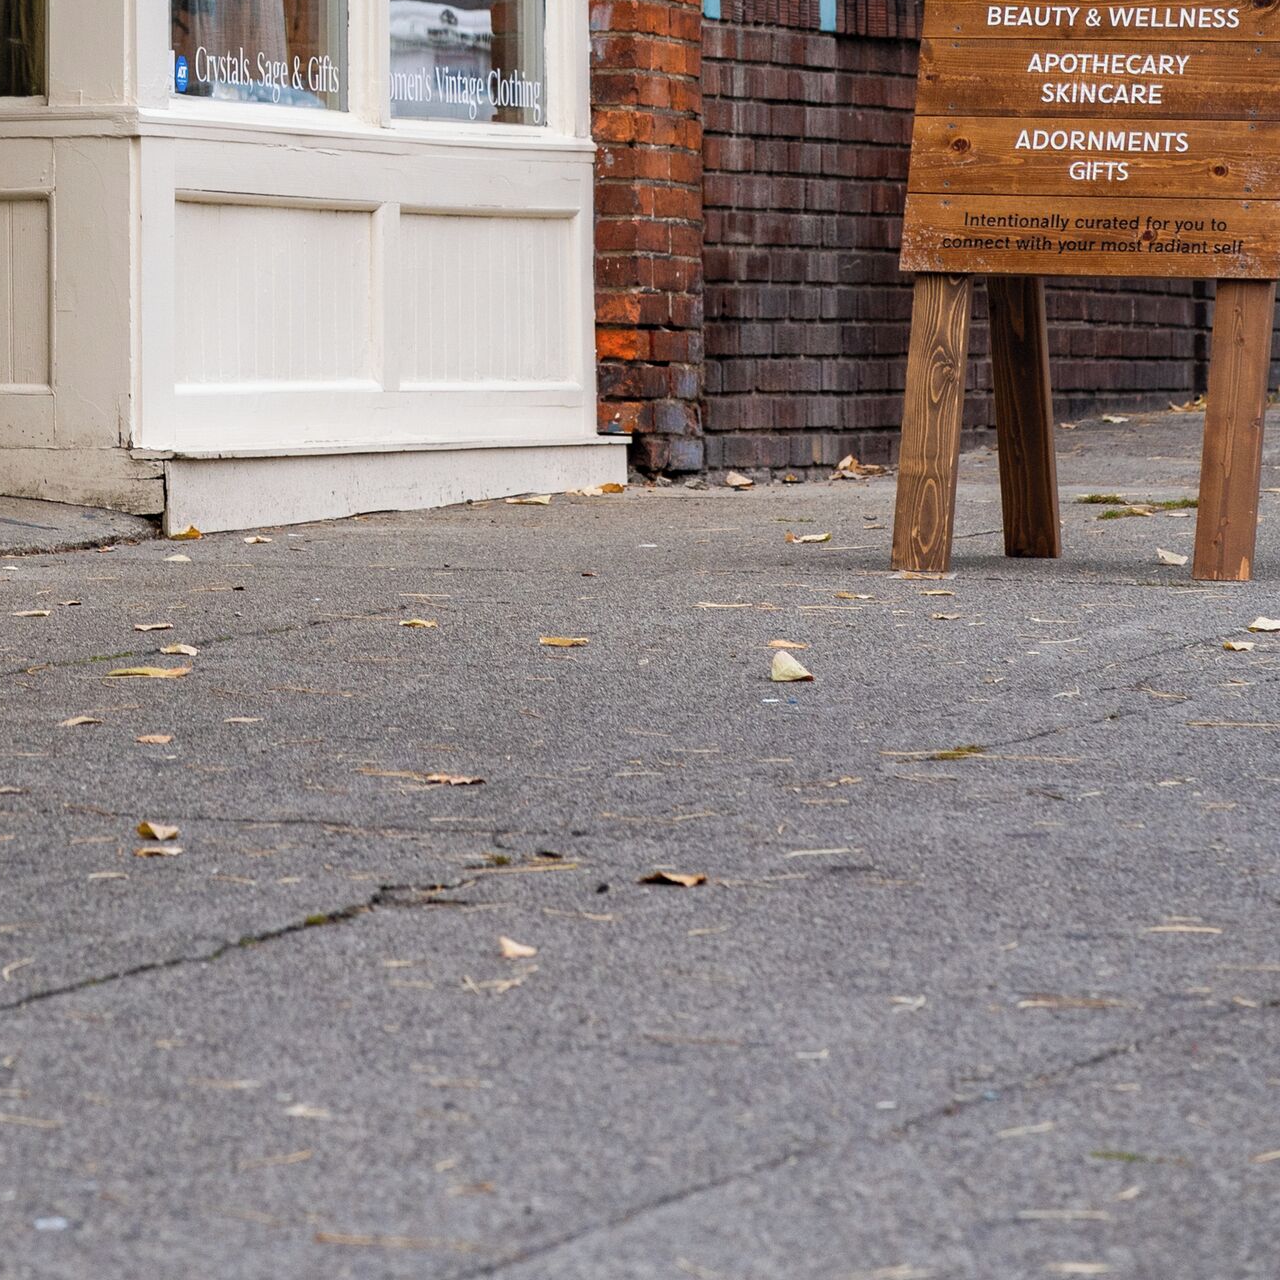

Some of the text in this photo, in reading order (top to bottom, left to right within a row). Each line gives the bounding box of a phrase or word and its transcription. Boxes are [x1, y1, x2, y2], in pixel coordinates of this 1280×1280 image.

[987, 6, 1240, 29] BEAUTY & WELLNESS
[195, 46, 340, 104] Crystals, Sage & Gifts
[1027, 53, 1191, 75] APOTHECARY
[435, 66, 484, 120] Vintage
[487, 68, 541, 124] Clothing
[1041, 83, 1163, 105] SKINCARE
[1015, 130, 1189, 153] ADORNMENTS
[1069, 161, 1129, 182] GIFTS
[964, 212, 1227, 233] Intentionally curated for you to
[942, 235, 1244, 256] connect with your most radiant self
